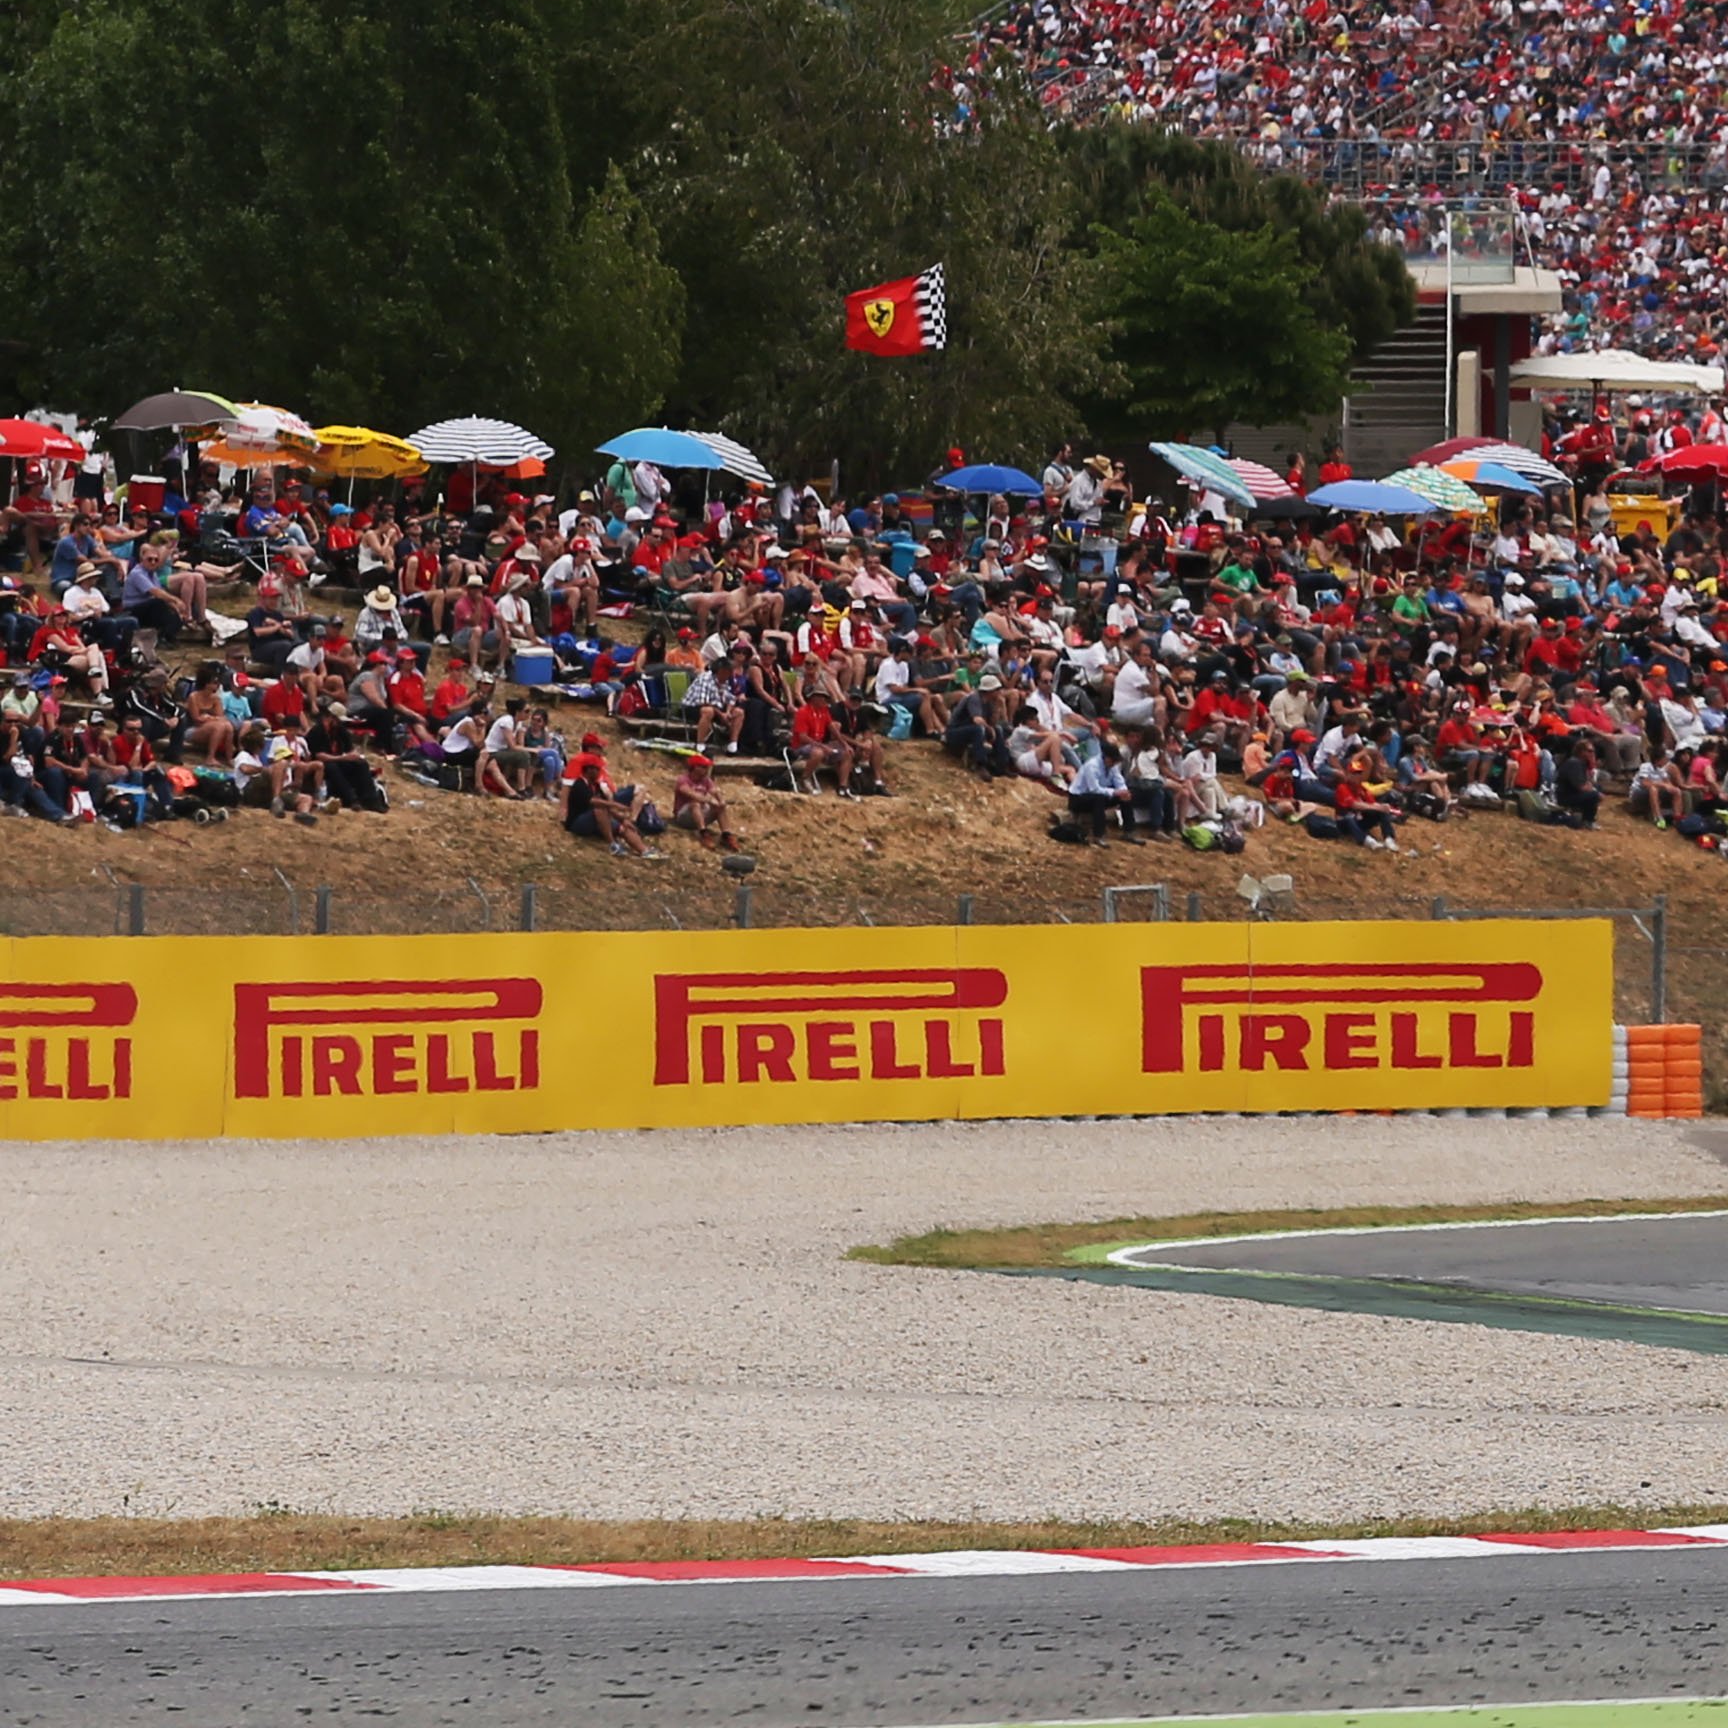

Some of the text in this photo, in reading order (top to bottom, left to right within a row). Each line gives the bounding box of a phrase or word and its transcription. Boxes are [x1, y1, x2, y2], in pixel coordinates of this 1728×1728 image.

[234, 978, 543, 1099] PIRELLI
[653, 968, 1009, 1086] PIRELLI
[1140, 962, 1543, 1073] PIRELLI
